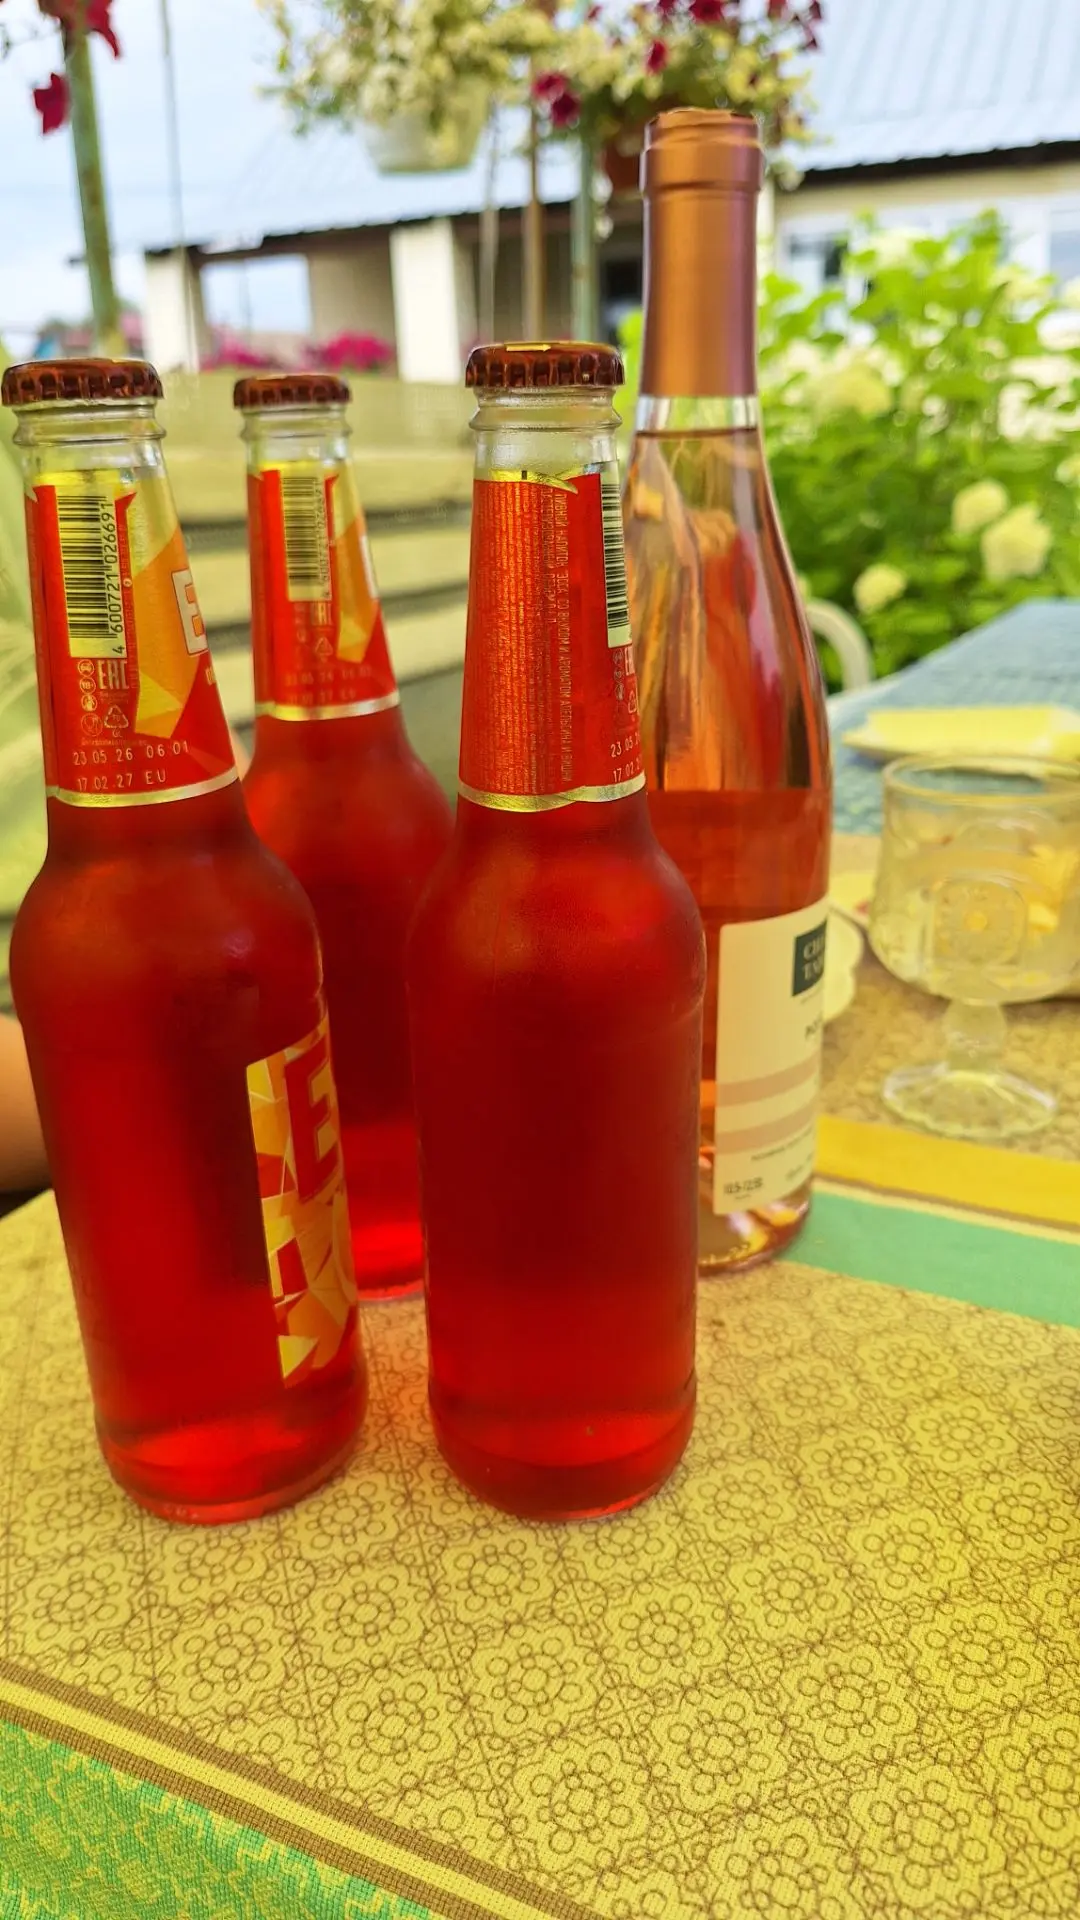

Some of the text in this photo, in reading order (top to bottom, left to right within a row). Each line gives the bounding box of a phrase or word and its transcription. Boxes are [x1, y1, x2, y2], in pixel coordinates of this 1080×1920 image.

[555, 493, 568, 527] ПИВНОЙ
[100, 502, 118, 564] 026691
[105, 574, 124, 634] 600721
[557, 612, 570, 645] ВКУСОМ
[559, 656, 572, 697] АРОМАТОМ
[145, 769, 166, 785] EU
